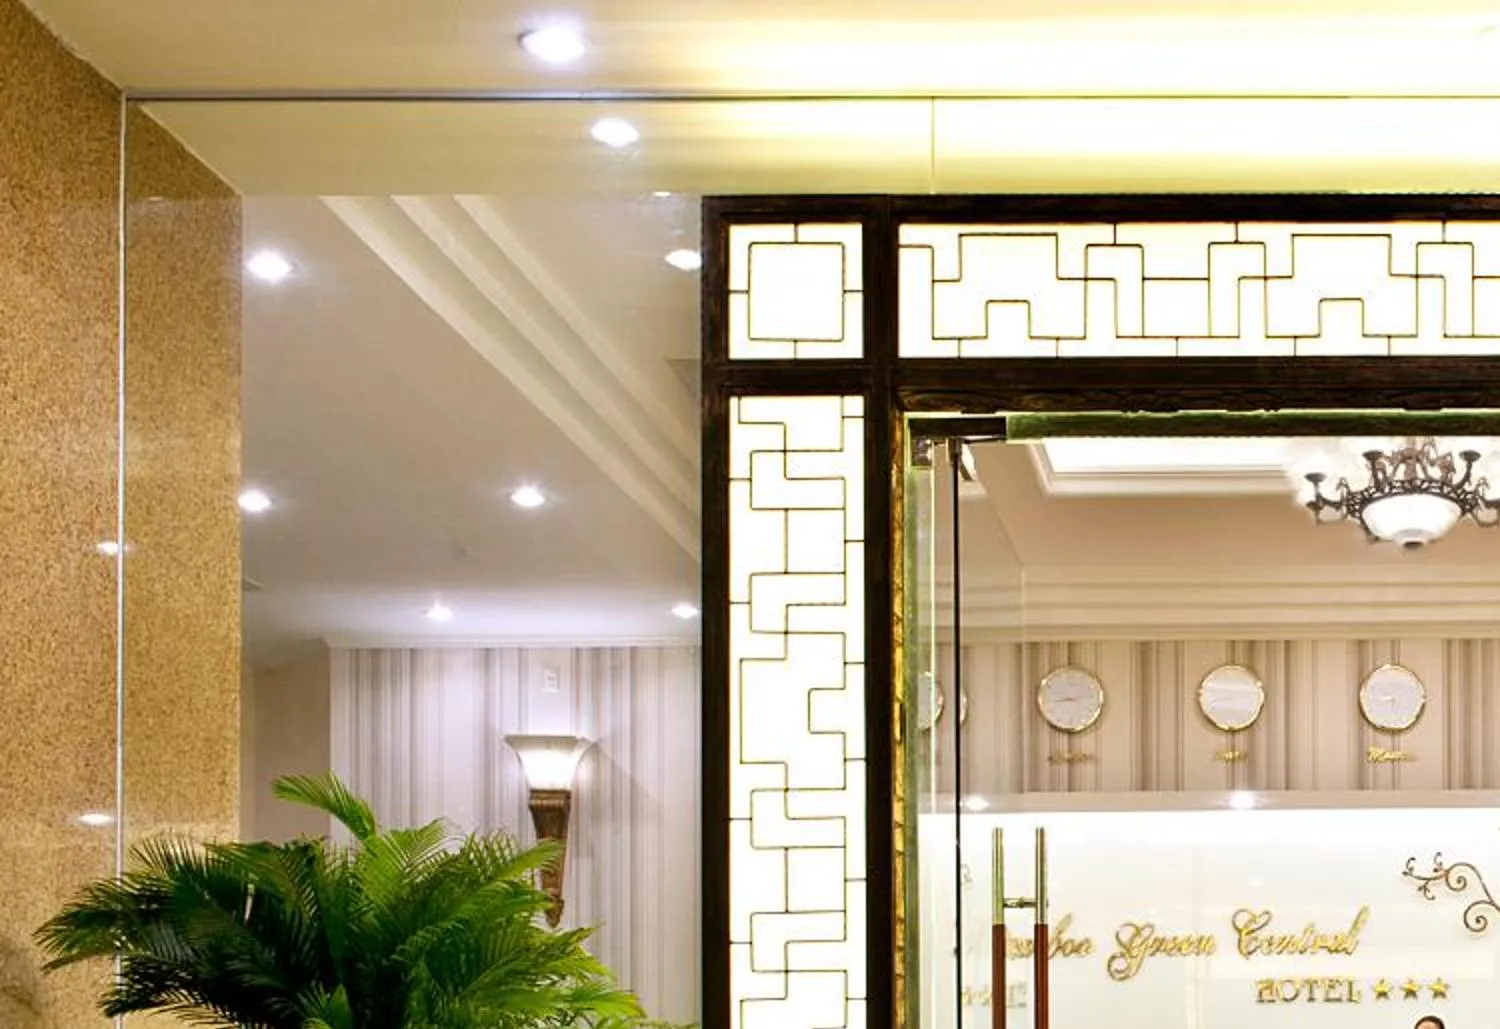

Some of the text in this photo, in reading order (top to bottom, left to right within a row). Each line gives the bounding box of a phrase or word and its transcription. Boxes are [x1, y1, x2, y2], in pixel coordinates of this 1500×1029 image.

[1107, 922, 1217, 982] Green
[1231, 905, 1371, 960] Central
[1255, 977, 1361, 1004] HOTEL
